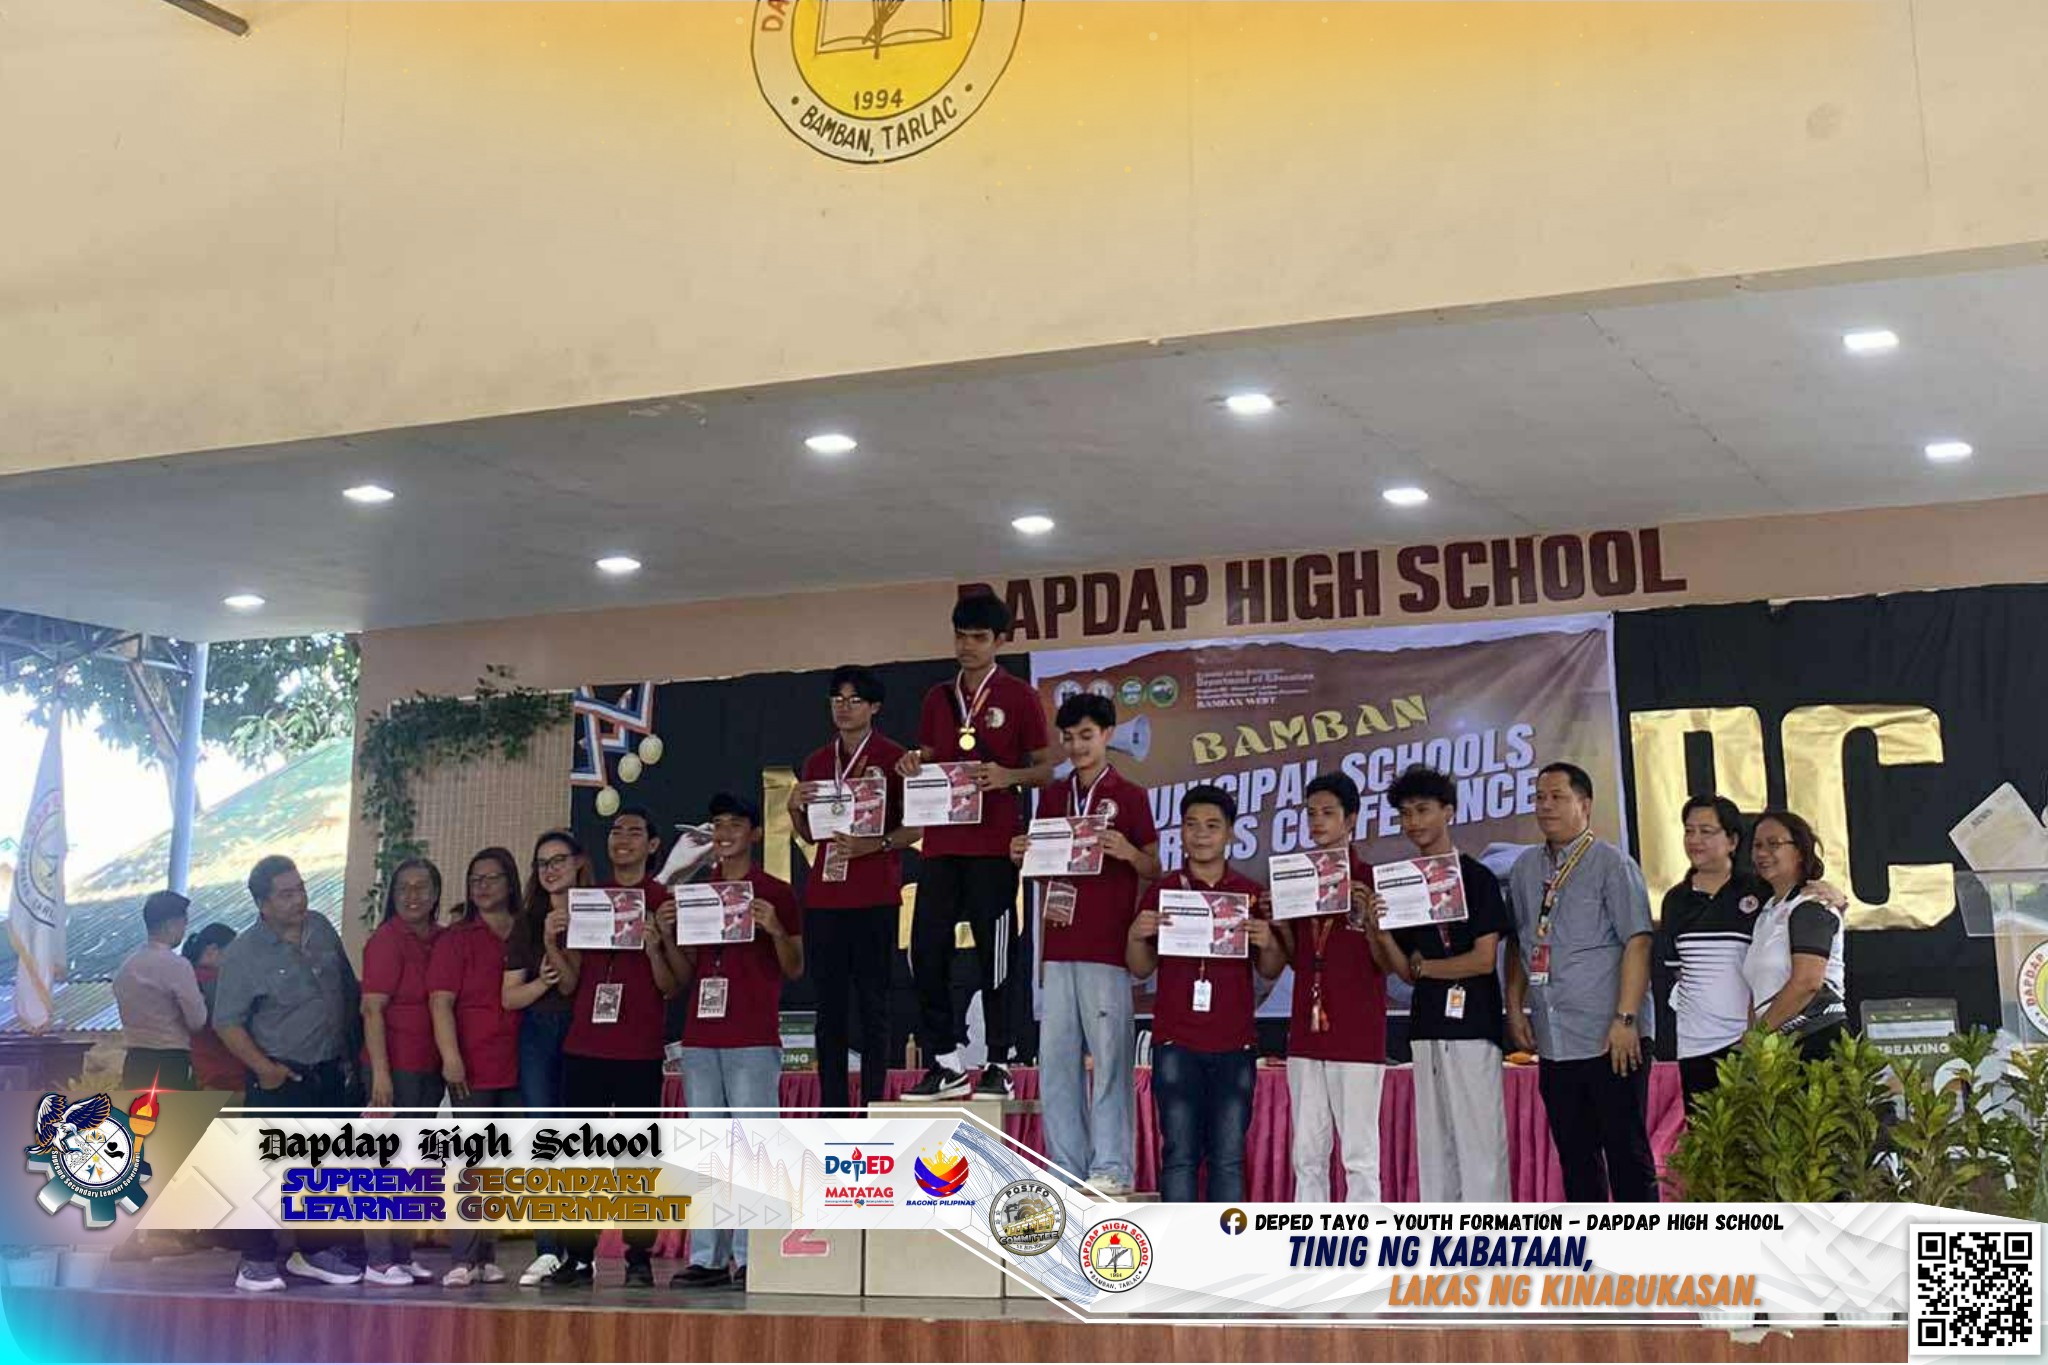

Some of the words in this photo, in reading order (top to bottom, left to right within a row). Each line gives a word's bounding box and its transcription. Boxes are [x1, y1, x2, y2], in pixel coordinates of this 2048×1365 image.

[800, 104, 875, 157] BAMBAN,
[880, 96, 957, 150] TARLAC
[853, 88, 904, 111] 1994
[1225, 549, 1381, 626] HIGH
[1396, 528, 1688, 613] SCHOOL
[1191, 695, 1428, 765] BAMBAN
